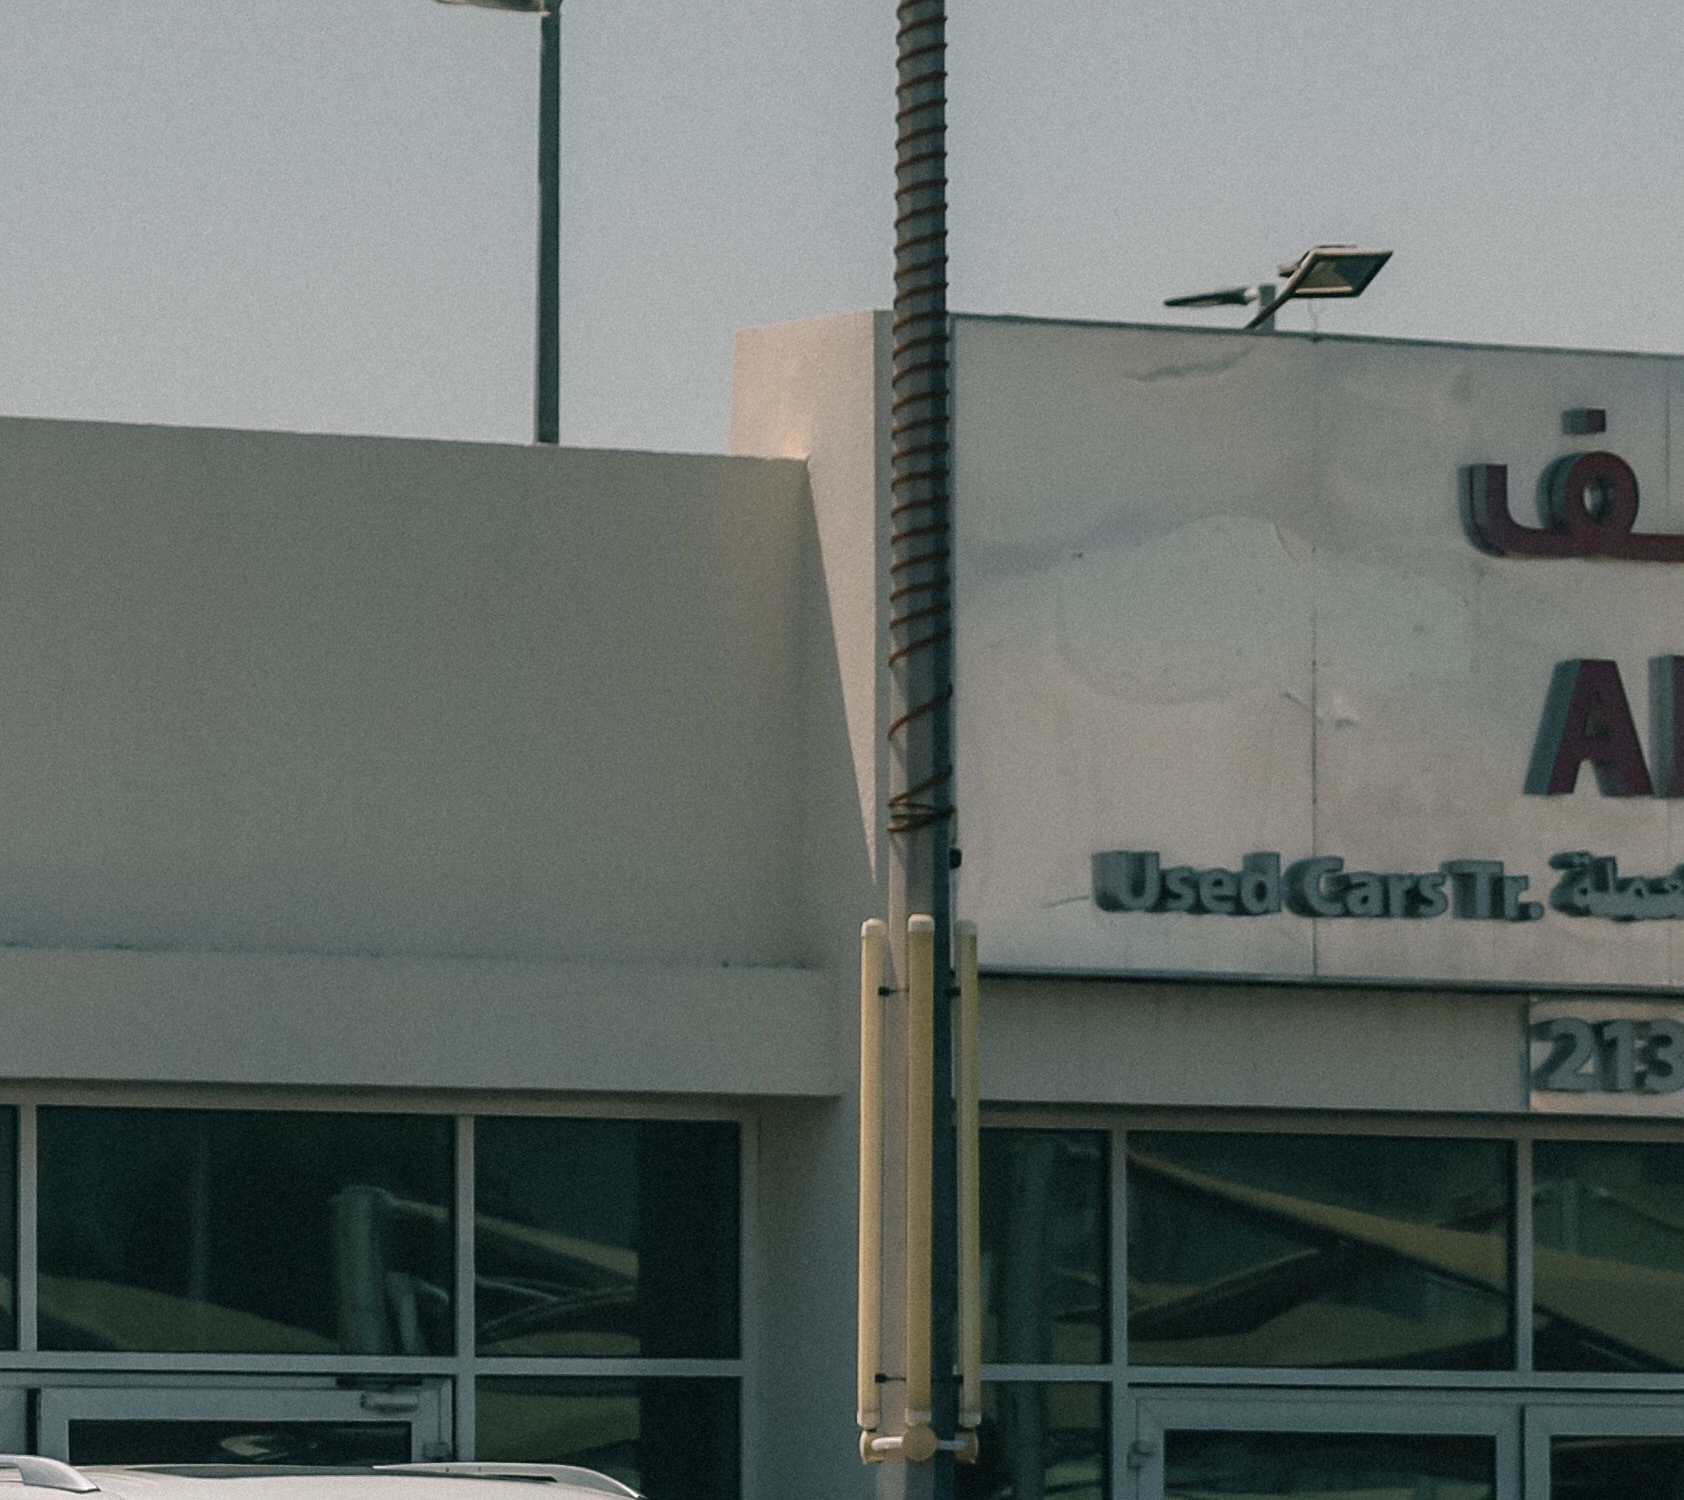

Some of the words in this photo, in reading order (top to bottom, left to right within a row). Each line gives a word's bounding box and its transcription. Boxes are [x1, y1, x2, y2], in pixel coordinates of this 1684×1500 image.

[1092, 850, 1282, 916] Used
[1284, 855, 1448, 919] Cars
[1440, 859, 1546, 922] Tr.
